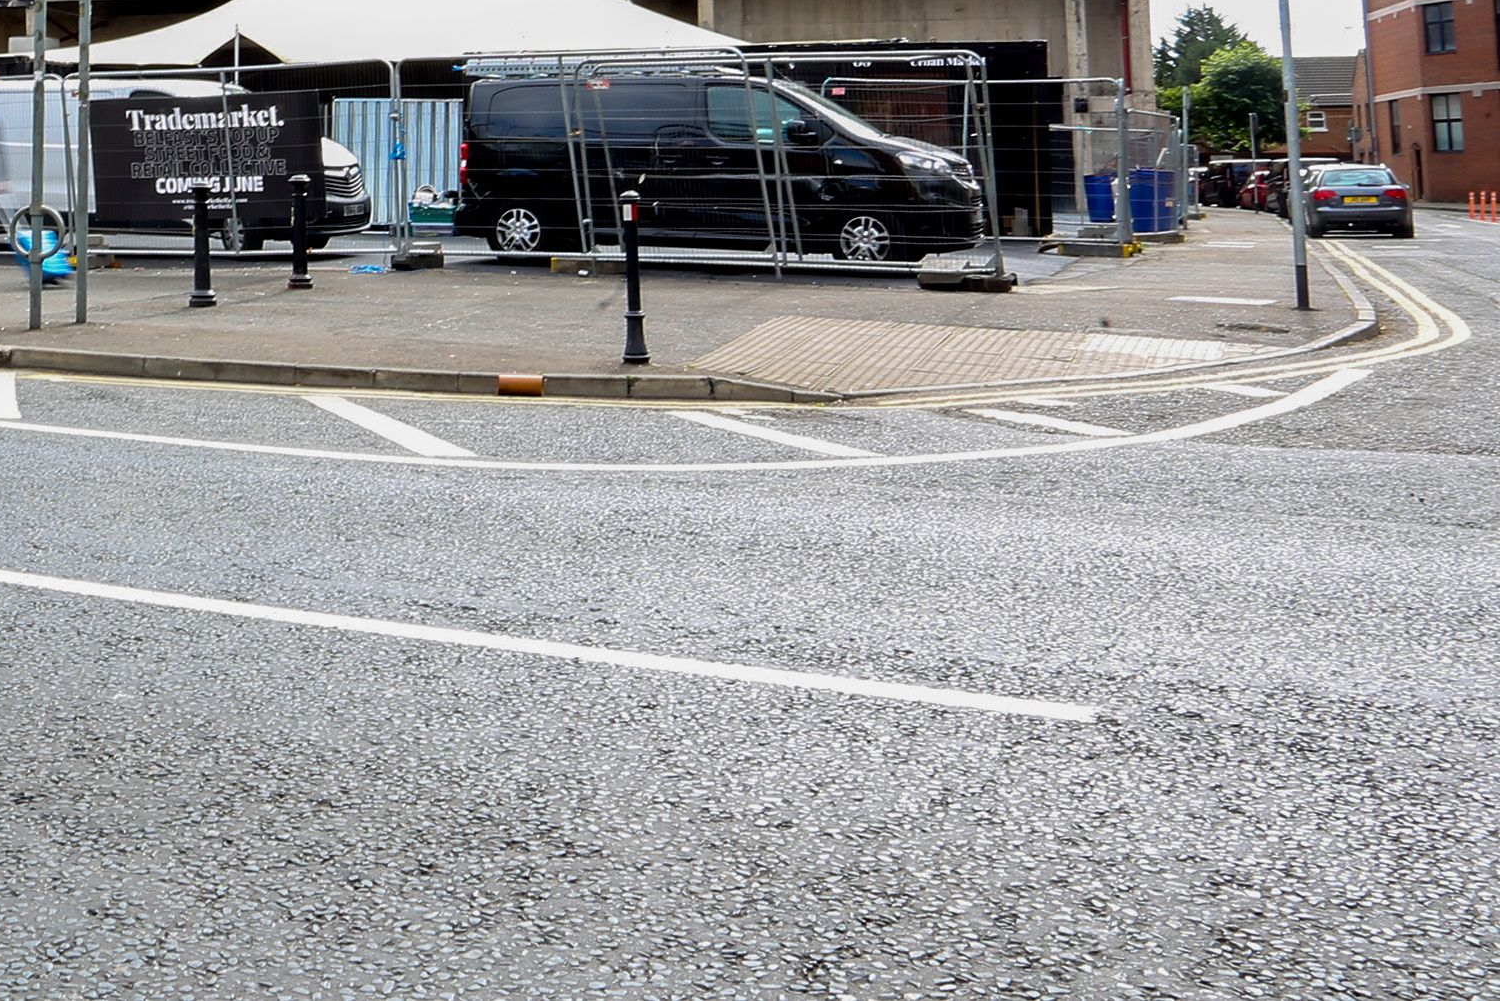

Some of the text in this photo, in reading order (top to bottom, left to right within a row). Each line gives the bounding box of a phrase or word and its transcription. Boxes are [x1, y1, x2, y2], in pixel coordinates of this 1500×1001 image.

[126, 104, 285, 131] Trademarket.
[256, 127, 281, 144] UP
[144, 143, 272, 163] STREET FOOD &
[131, 158, 287, 179] RETAIL COLLECTIVE
